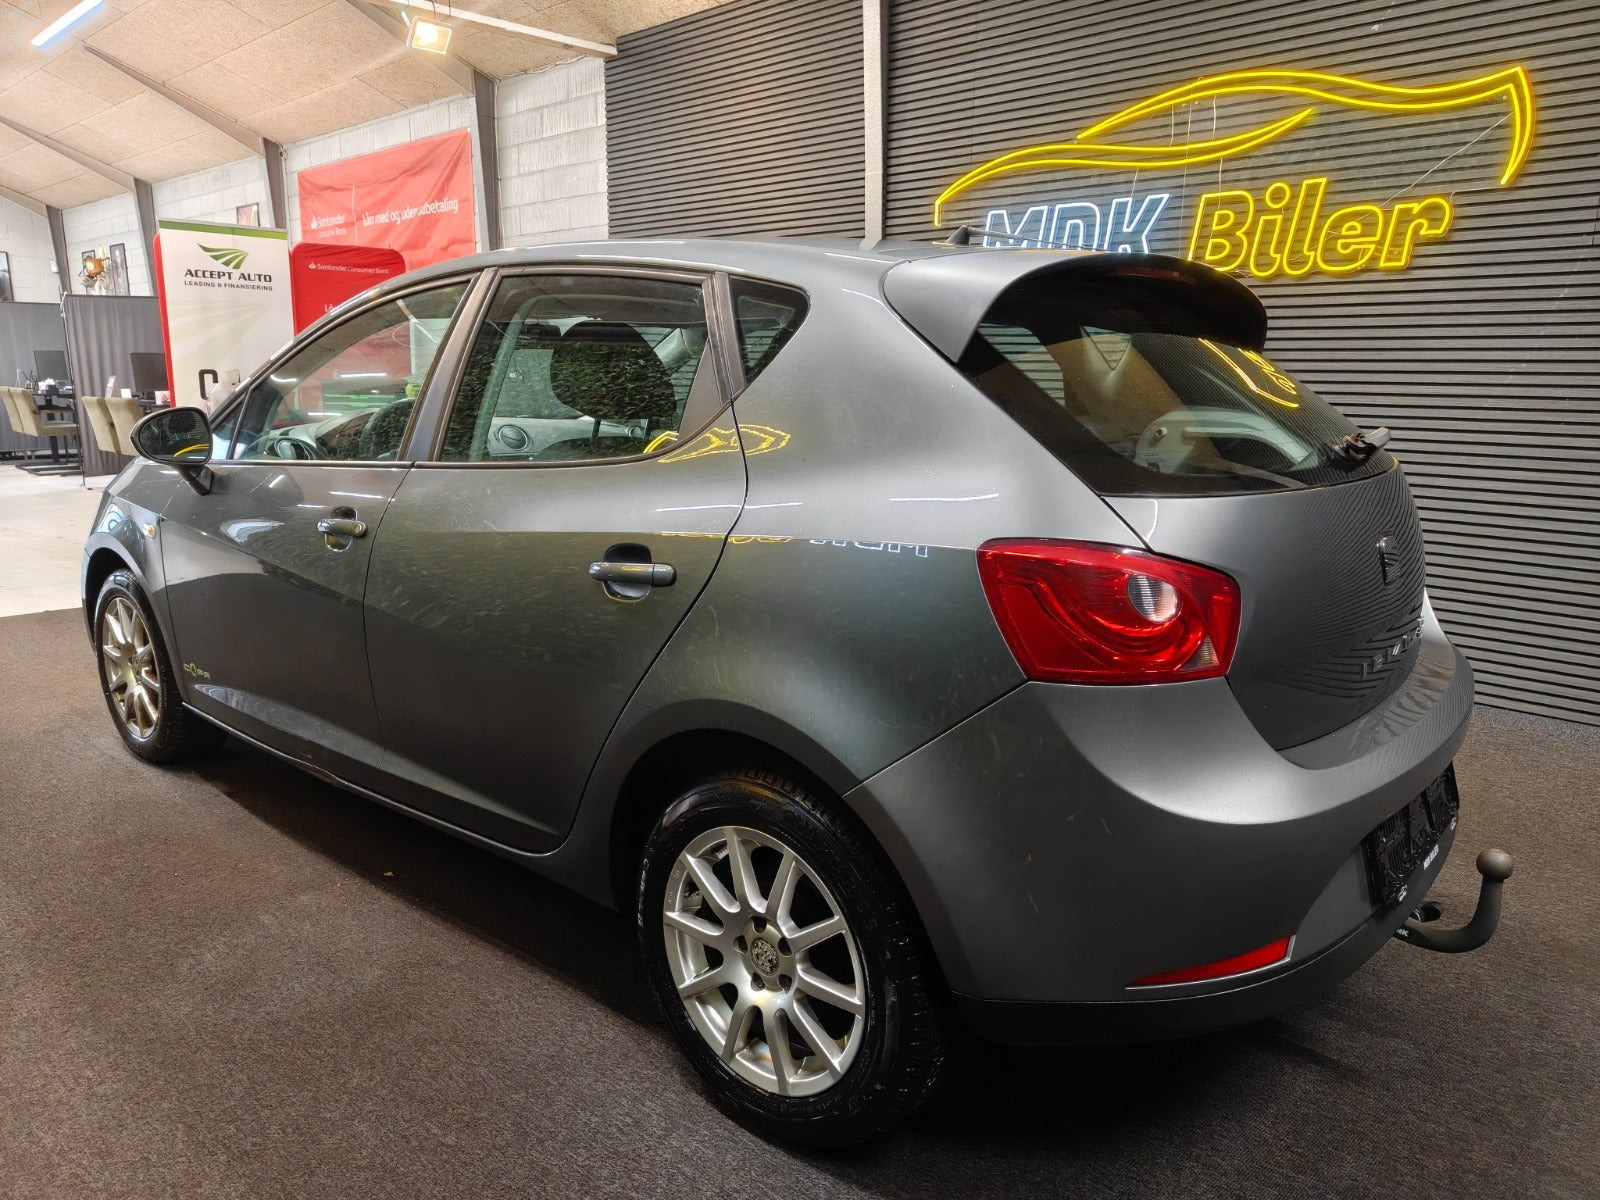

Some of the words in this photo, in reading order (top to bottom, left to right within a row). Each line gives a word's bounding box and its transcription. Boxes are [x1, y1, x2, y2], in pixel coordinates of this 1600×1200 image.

[390, 210, 400, 225] og
[418, 197, 459, 216] dbetaling
[983, 193, 1170, 253] MDK
[1187, 177, 1451, 277] Biler
[317, 263, 346, 272] Santander
[184, 269, 233, 280] ACCEPT
[238, 272, 272, 283] AUTO
[184, 280, 216, 288] LEASING
[224, 283, 273, 291] FINANSIERING
